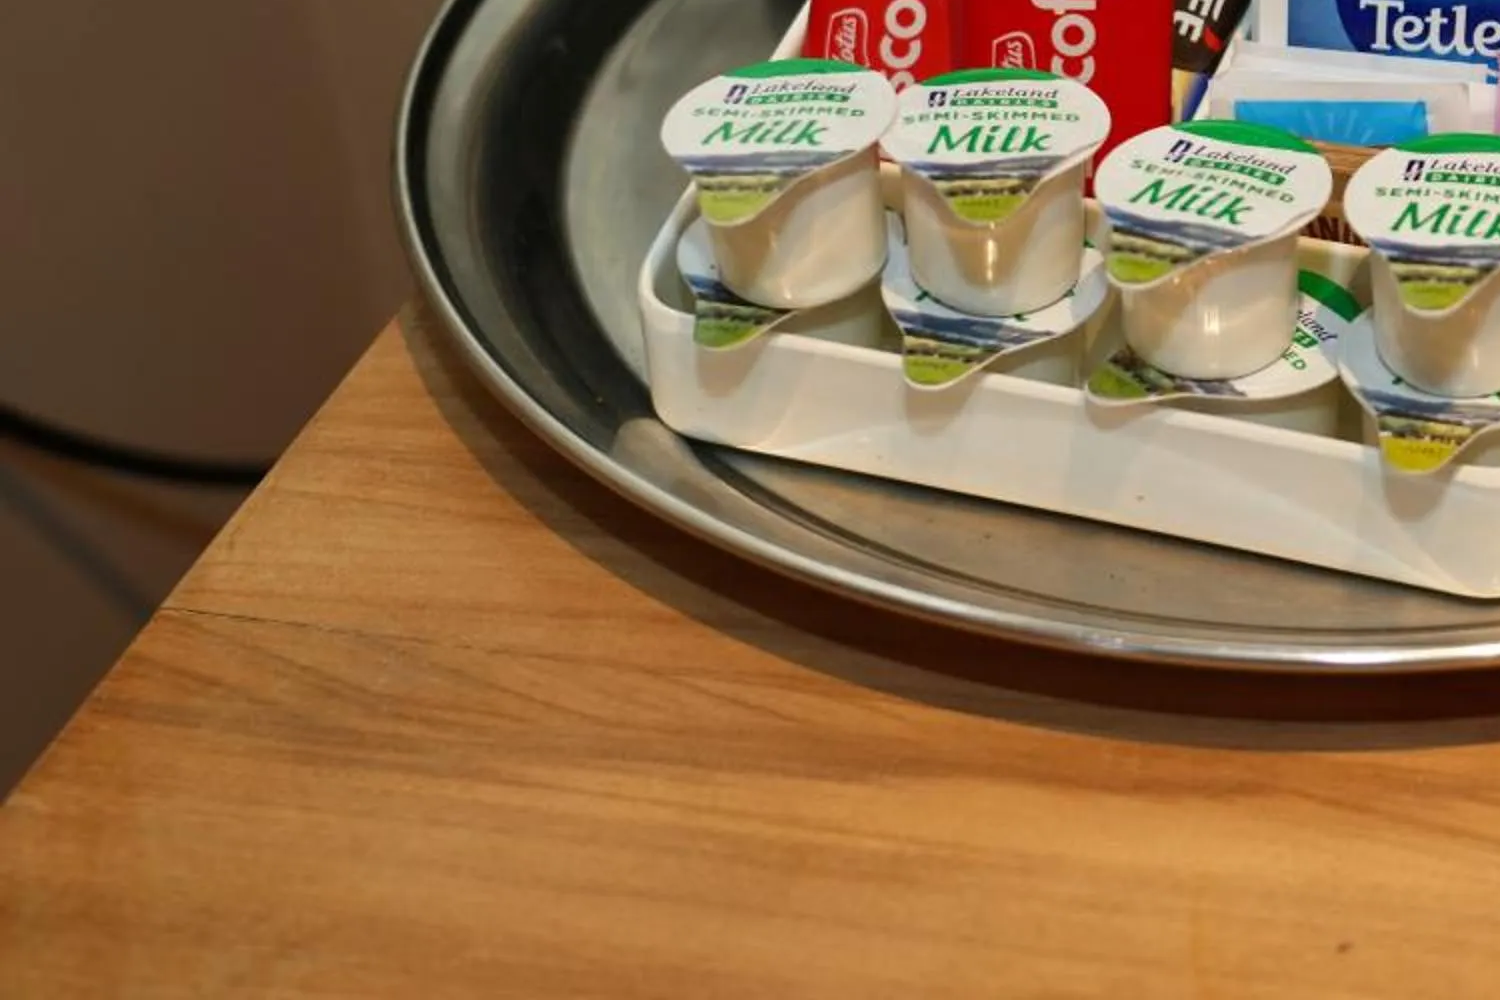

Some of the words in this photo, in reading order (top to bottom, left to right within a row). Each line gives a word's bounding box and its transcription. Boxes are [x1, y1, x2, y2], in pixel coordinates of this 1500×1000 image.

[751, 80, 857, 95] Lakeland
[952, 86, 1059, 99] Lakeland
[692, 106, 866, 118] SEMI-SKIMMED
[902, 111, 1080, 125] SEMI-SKIMMED
[701, 118, 828, 146] Milk
[927, 124, 1053, 154] Milk
[1193, 144, 1298, 176] Lakeland
[1130, 159, 1297, 204] SEMI-SKIMMED
[1128, 178, 1254, 225] Milk
